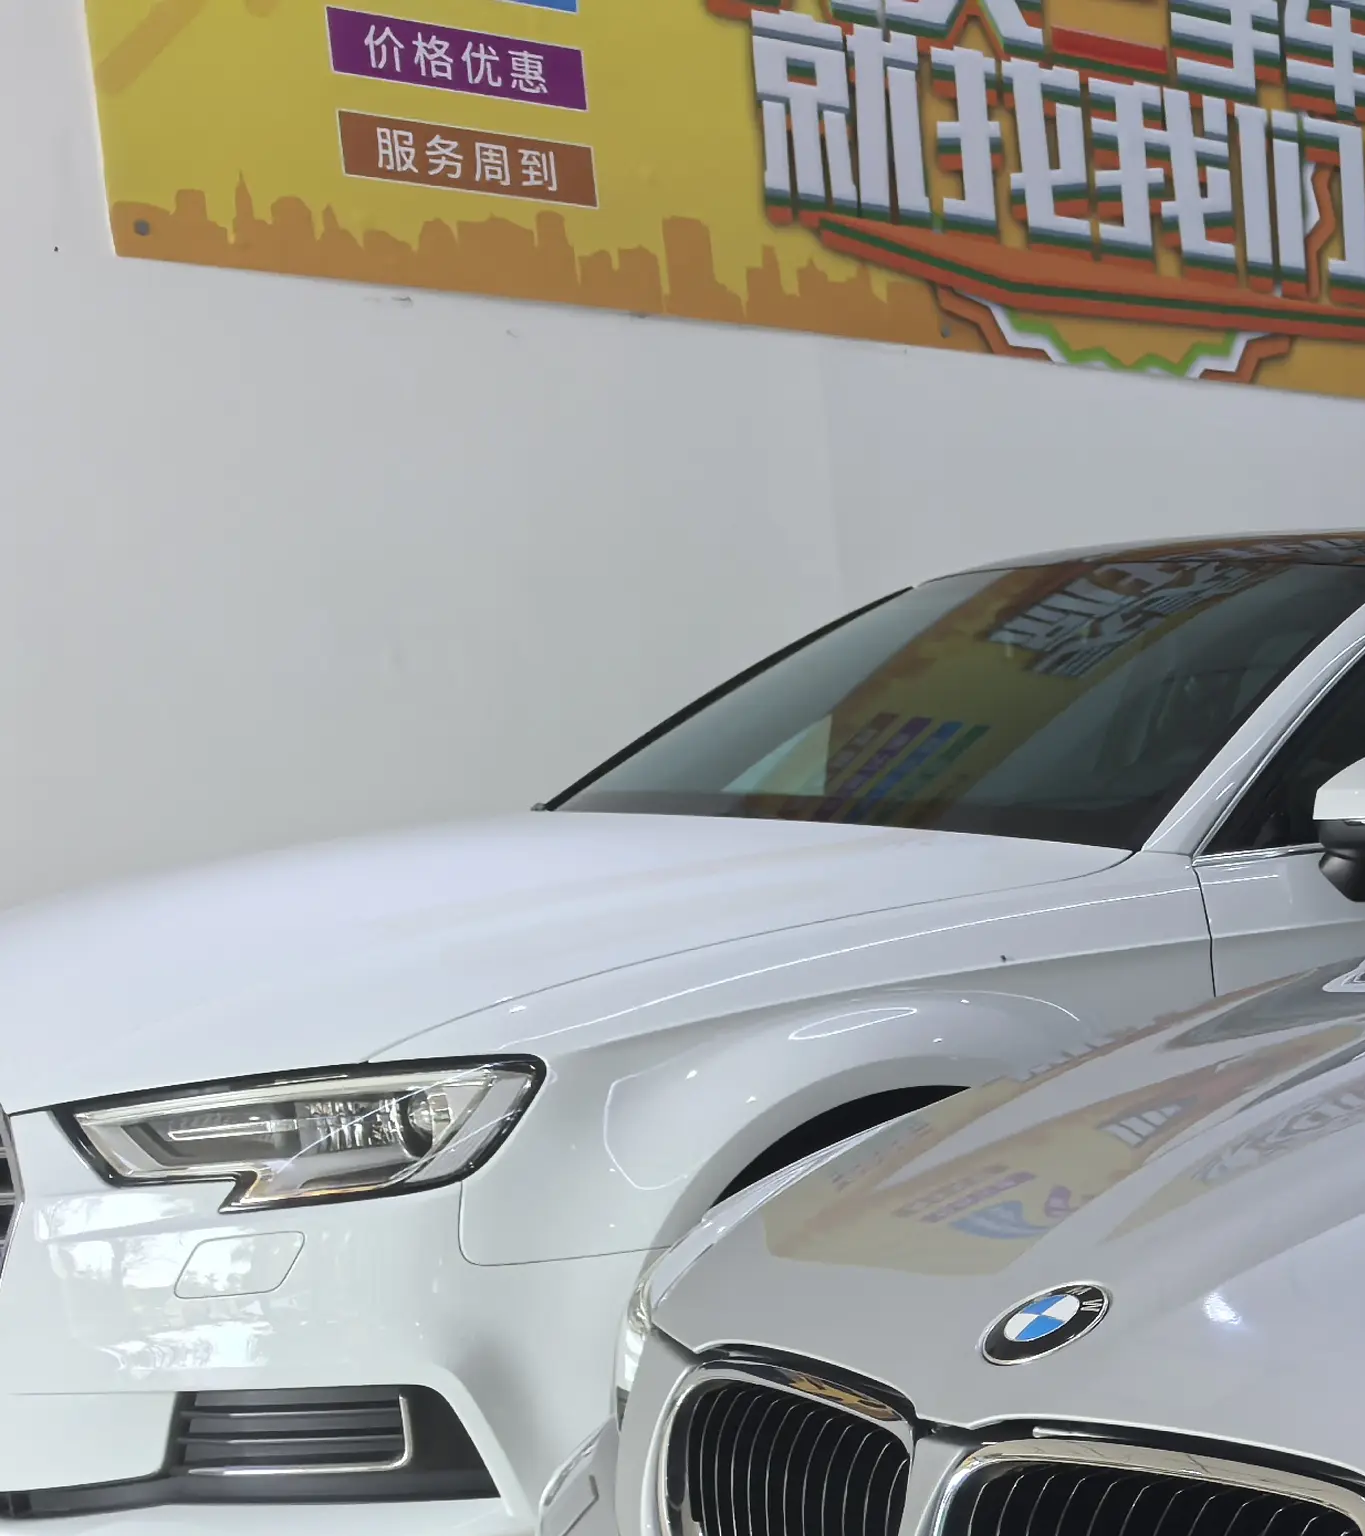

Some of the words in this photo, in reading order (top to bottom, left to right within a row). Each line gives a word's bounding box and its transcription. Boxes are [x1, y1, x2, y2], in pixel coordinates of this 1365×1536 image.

[362, 24, 549, 95] 价格优惠
[376, 126, 559, 192] 服务周到
